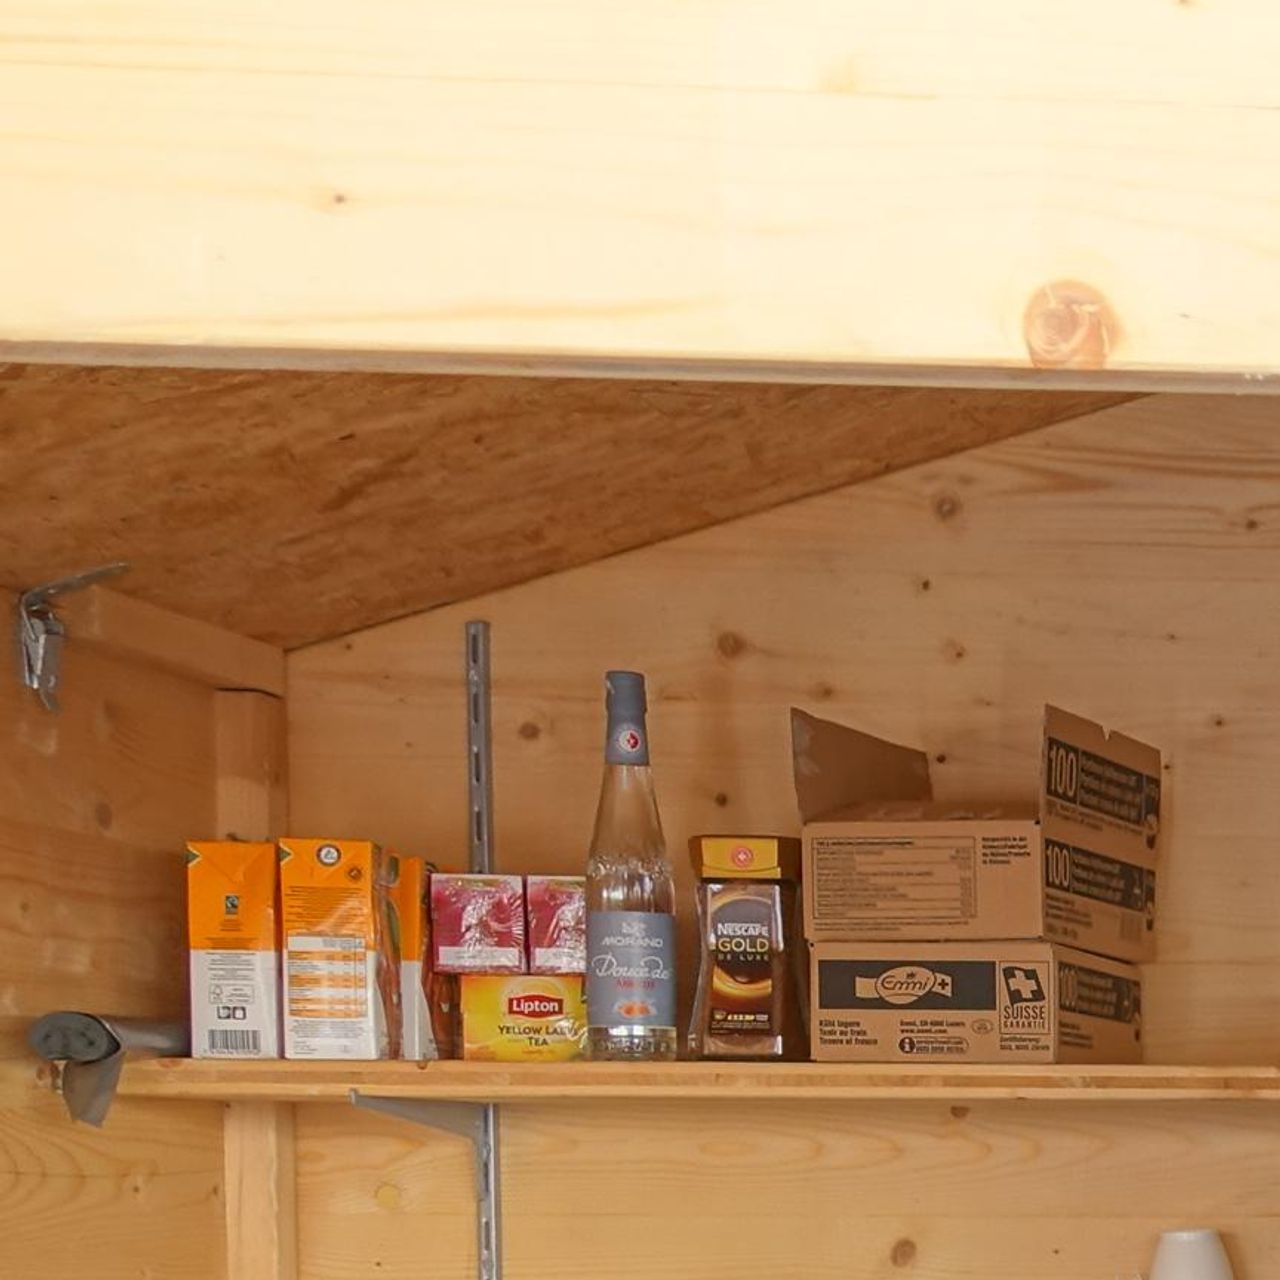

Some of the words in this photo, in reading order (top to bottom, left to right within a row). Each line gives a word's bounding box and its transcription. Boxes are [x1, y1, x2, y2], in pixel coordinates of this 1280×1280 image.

[1049, 743, 1078, 797] 100
[1046, 843, 1070, 888] 100
[717, 937, 770, 952] GOLD
[739, 953, 770, 962] LUXE
[880, 975, 931, 991] Emmi
[512, 1000, 559, 1015] Lipton
[1003, 1005, 1046, 1021] SUISSE
[497, 1025, 543, 1036] YELLOW
[1003, 1019, 1047, 1030] GARANTIE
[527, 1037, 549, 1047] TEA
